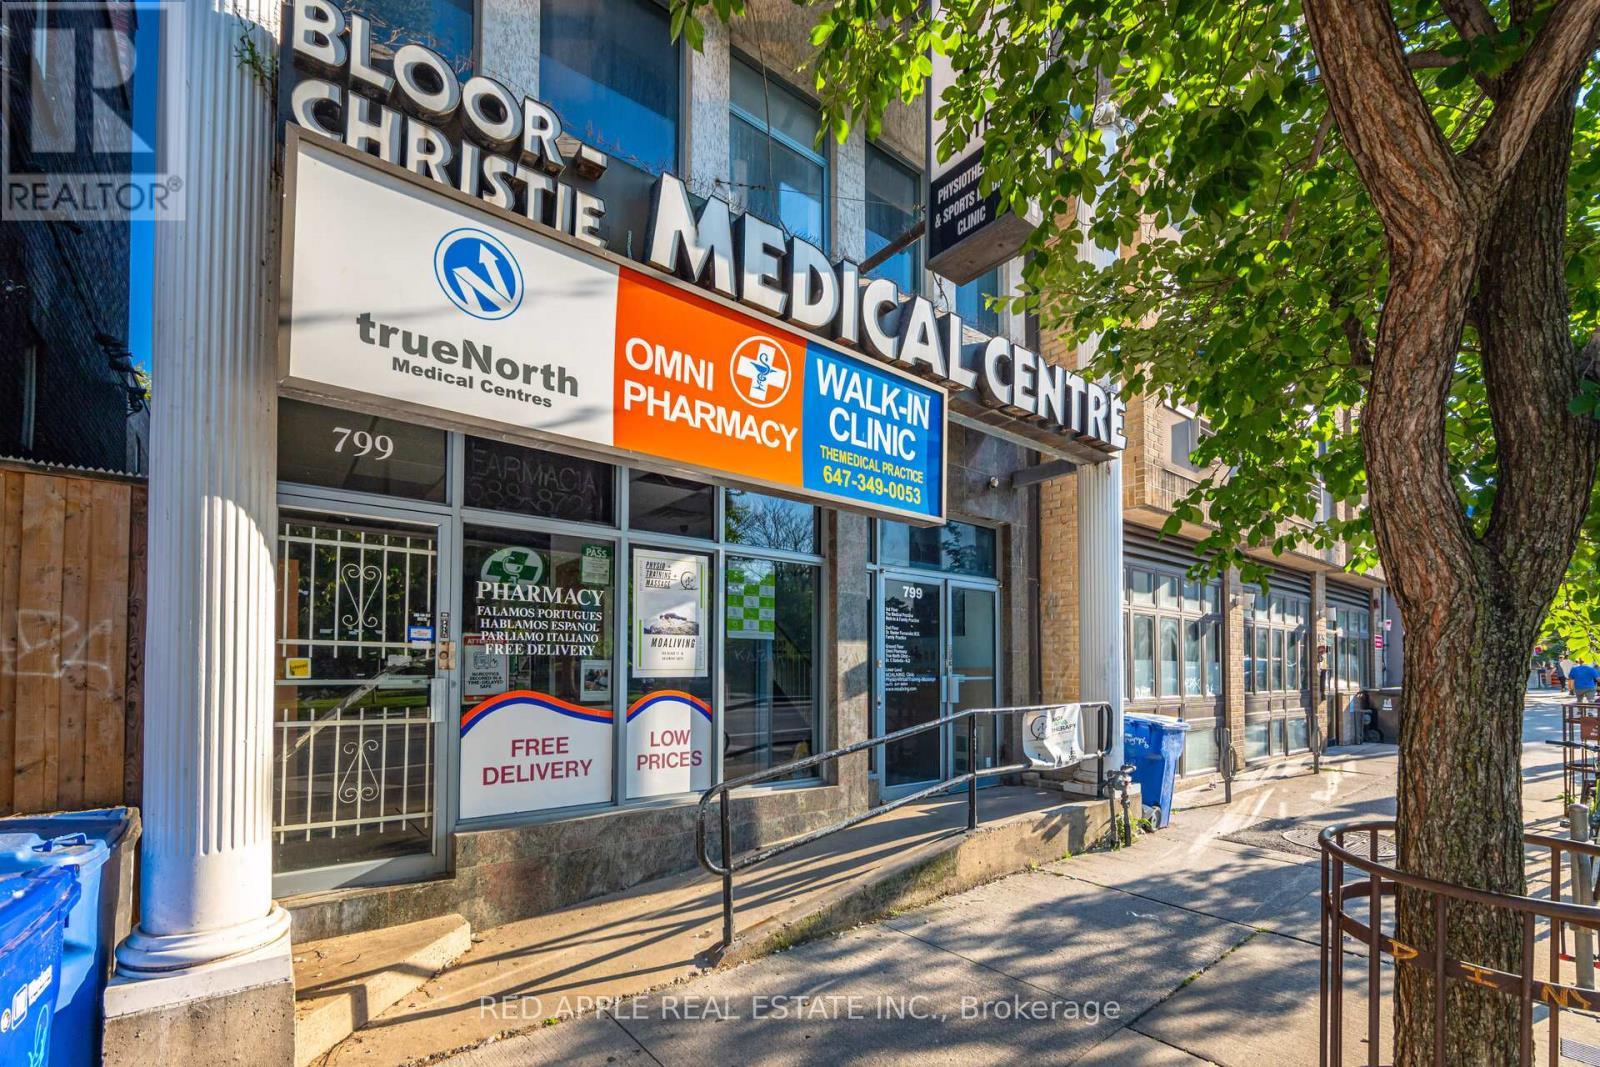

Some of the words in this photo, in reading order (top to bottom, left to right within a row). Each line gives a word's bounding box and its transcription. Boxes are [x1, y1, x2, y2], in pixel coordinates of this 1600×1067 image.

[291, 79, 608, 247] CHRISTIE
[934, 214, 943, 229] &
[943, 190, 975, 223] SPORTS
[957, 205, 986, 236] CLINIC
[646, 172, 978, 390] MEDICAL
[985, 336, 1127, 450] CENTRE
[356, 312, 579, 398] trueNorth
[625, 337, 714, 391] OMNI
[391, 356, 474, 389] Medical
[479, 376, 553, 409] Centres
[816, 358, 930, 430] WALK-IN
[624, 380, 798, 453] PHARMACY
[332, 427, 394, 460] 799
[829, 407, 916, 461] CLINIC
[822, 465, 922, 505] 647-349-0053
[882, 463, 924, 484] PRACTICE
[475, 581, 605, 606] PHARMACY
[902, 586, 923, 599] 799
[477, 606, 535, 618] FALAMOS
[538, 609, 603, 621] PORTUGUES
[480, 619, 549, 629] HABLAMOS
[551, 621, 600, 632] ESPANOL
[481, 631, 544, 642] PARLIAMO
[546, 633, 599, 643] ITALIANO
[485, 644, 525, 655] FREE
[527, 645, 596, 656] DELIVERY
[651, 637, 697, 648] MOALIVING
[511, 736, 569, 757] FREE
[650, 729, 691, 747] LOW
[482, 759, 593, 786] DELIVERY
[637, 750, 702, 770] PRICES
